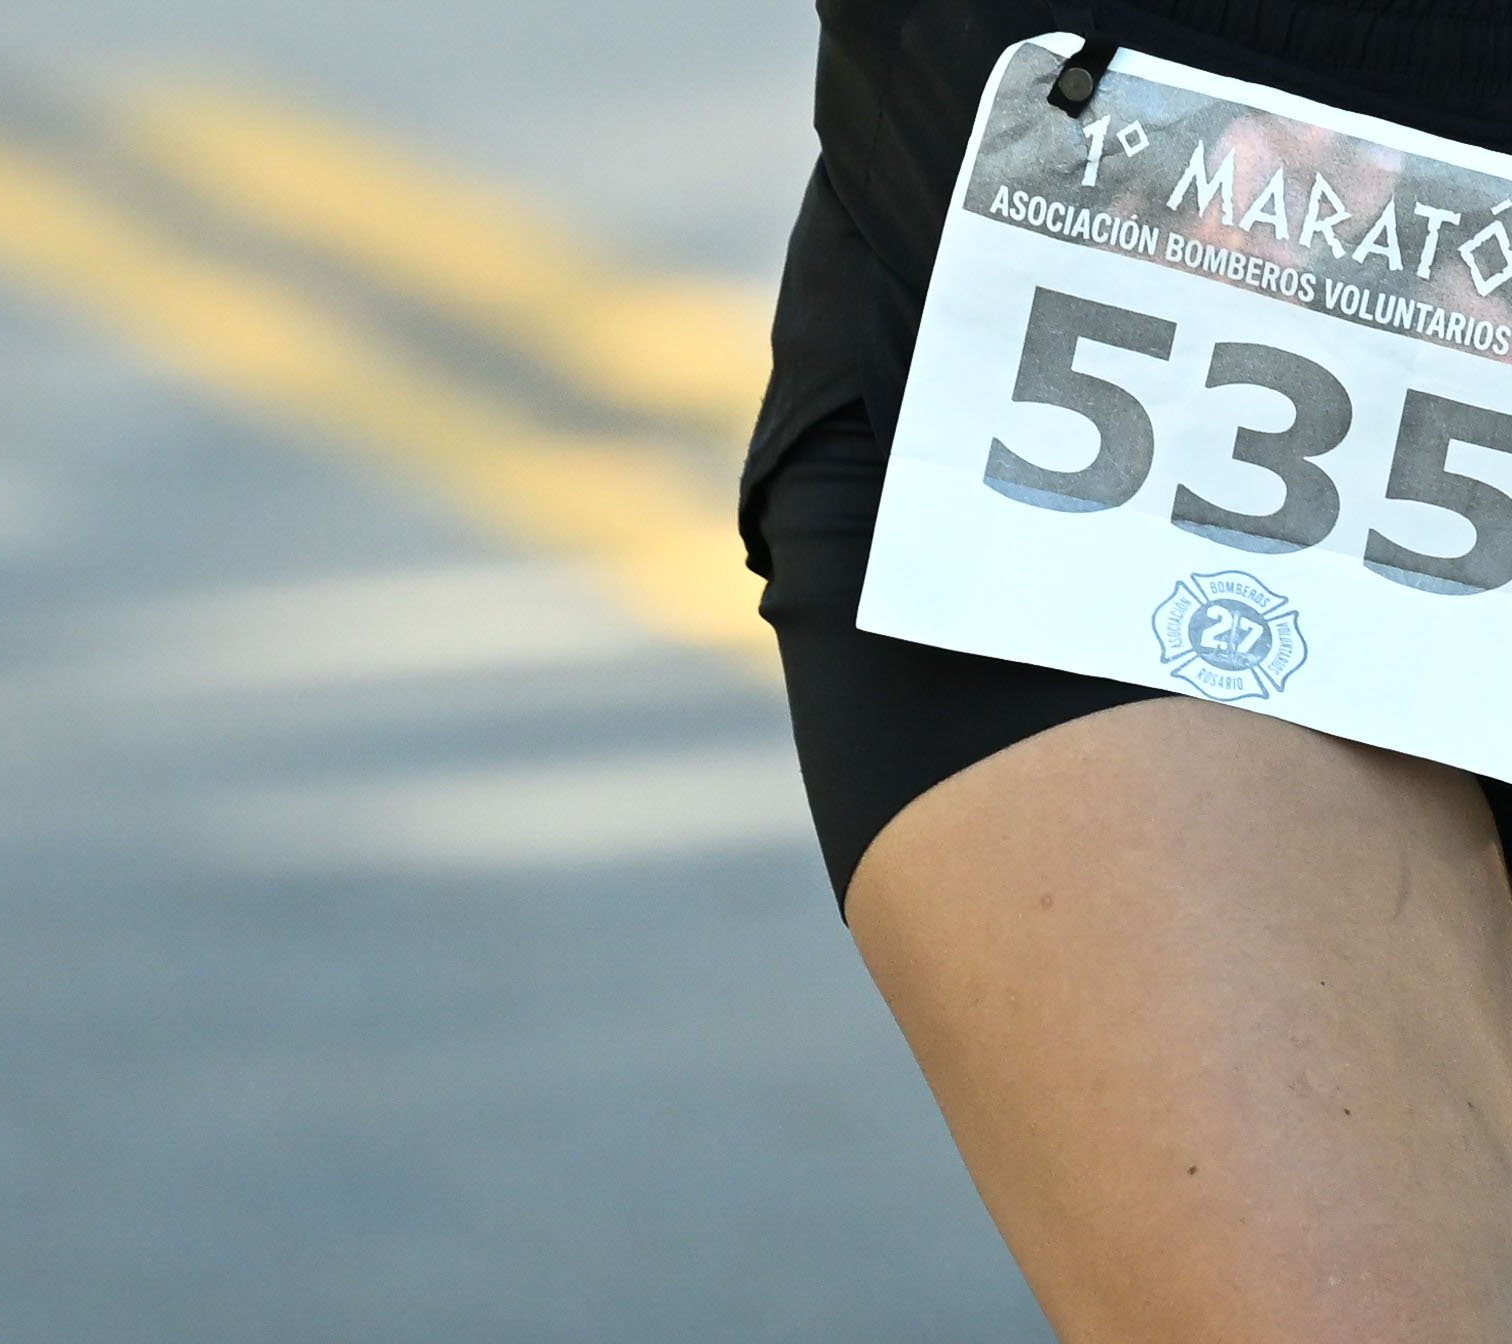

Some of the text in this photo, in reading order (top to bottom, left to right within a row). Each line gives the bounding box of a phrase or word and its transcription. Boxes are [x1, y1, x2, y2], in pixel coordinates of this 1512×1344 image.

[989, 185, 1160, 256] ASOCIACIÓN
[1165, 231, 1317, 303] BOMBEROS
[1325, 277, 1512, 356] VOLUNTARIOS
[1209, 580, 1271, 609] BOMBEROS
[1199, 604, 1264, 654] 27
[1197, 667, 1244, 691] ROSARIO
